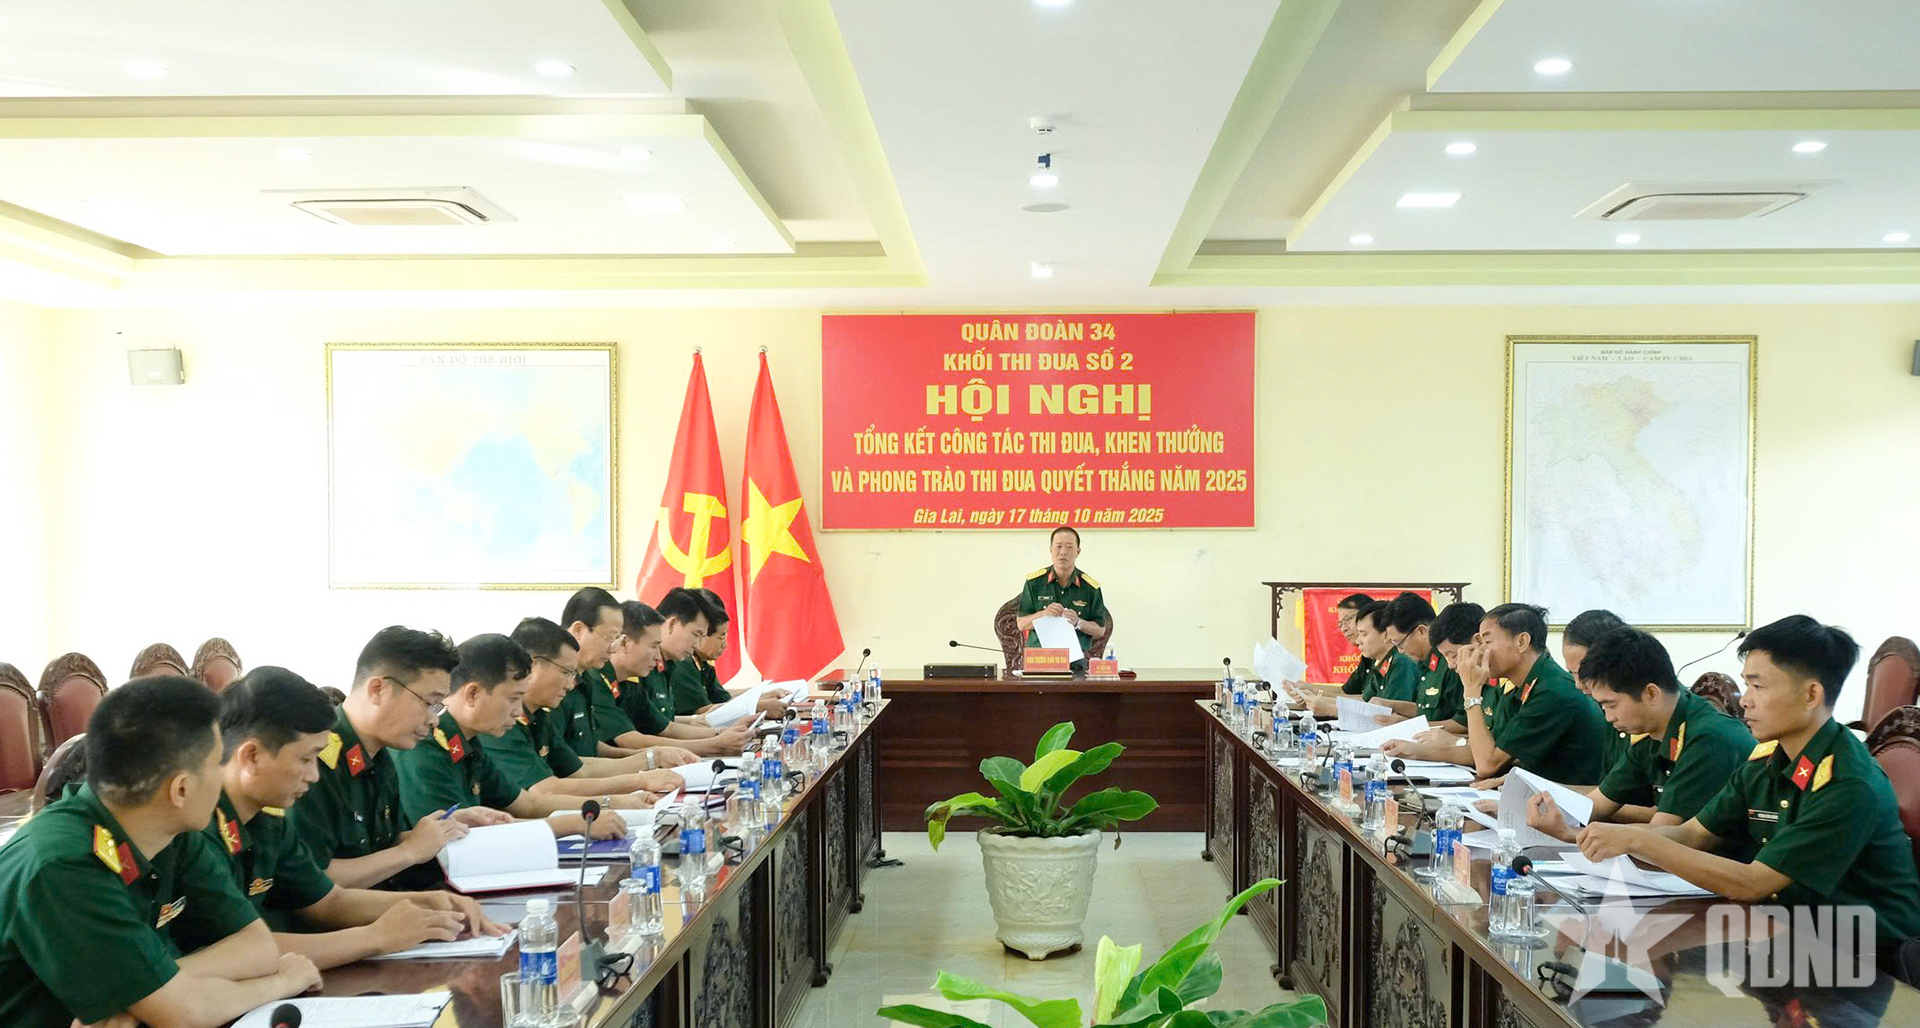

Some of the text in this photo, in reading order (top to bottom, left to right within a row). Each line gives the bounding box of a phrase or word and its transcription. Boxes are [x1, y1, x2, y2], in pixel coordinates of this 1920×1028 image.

[961, 319, 1116, 344] QUÂN ĐOÀN 34
[943, 347, 1134, 371] KHỐI THI ĐUA SỐ 2
[926, 377, 1152, 422] HỘI NGHỊ
[853, 423, 1225, 457] TỔNG KẾT CÔNG TÁC THI ĐUA, KHEN THƯỞNG
[830, 461, 1248, 495] VÀ PHONG TRÀO THI ĐUA QUYẾT THẮNG NĂM 2025
[913, 508, 1165, 525] Gia Lai, ngày 17 tháng 10 năm 2025
